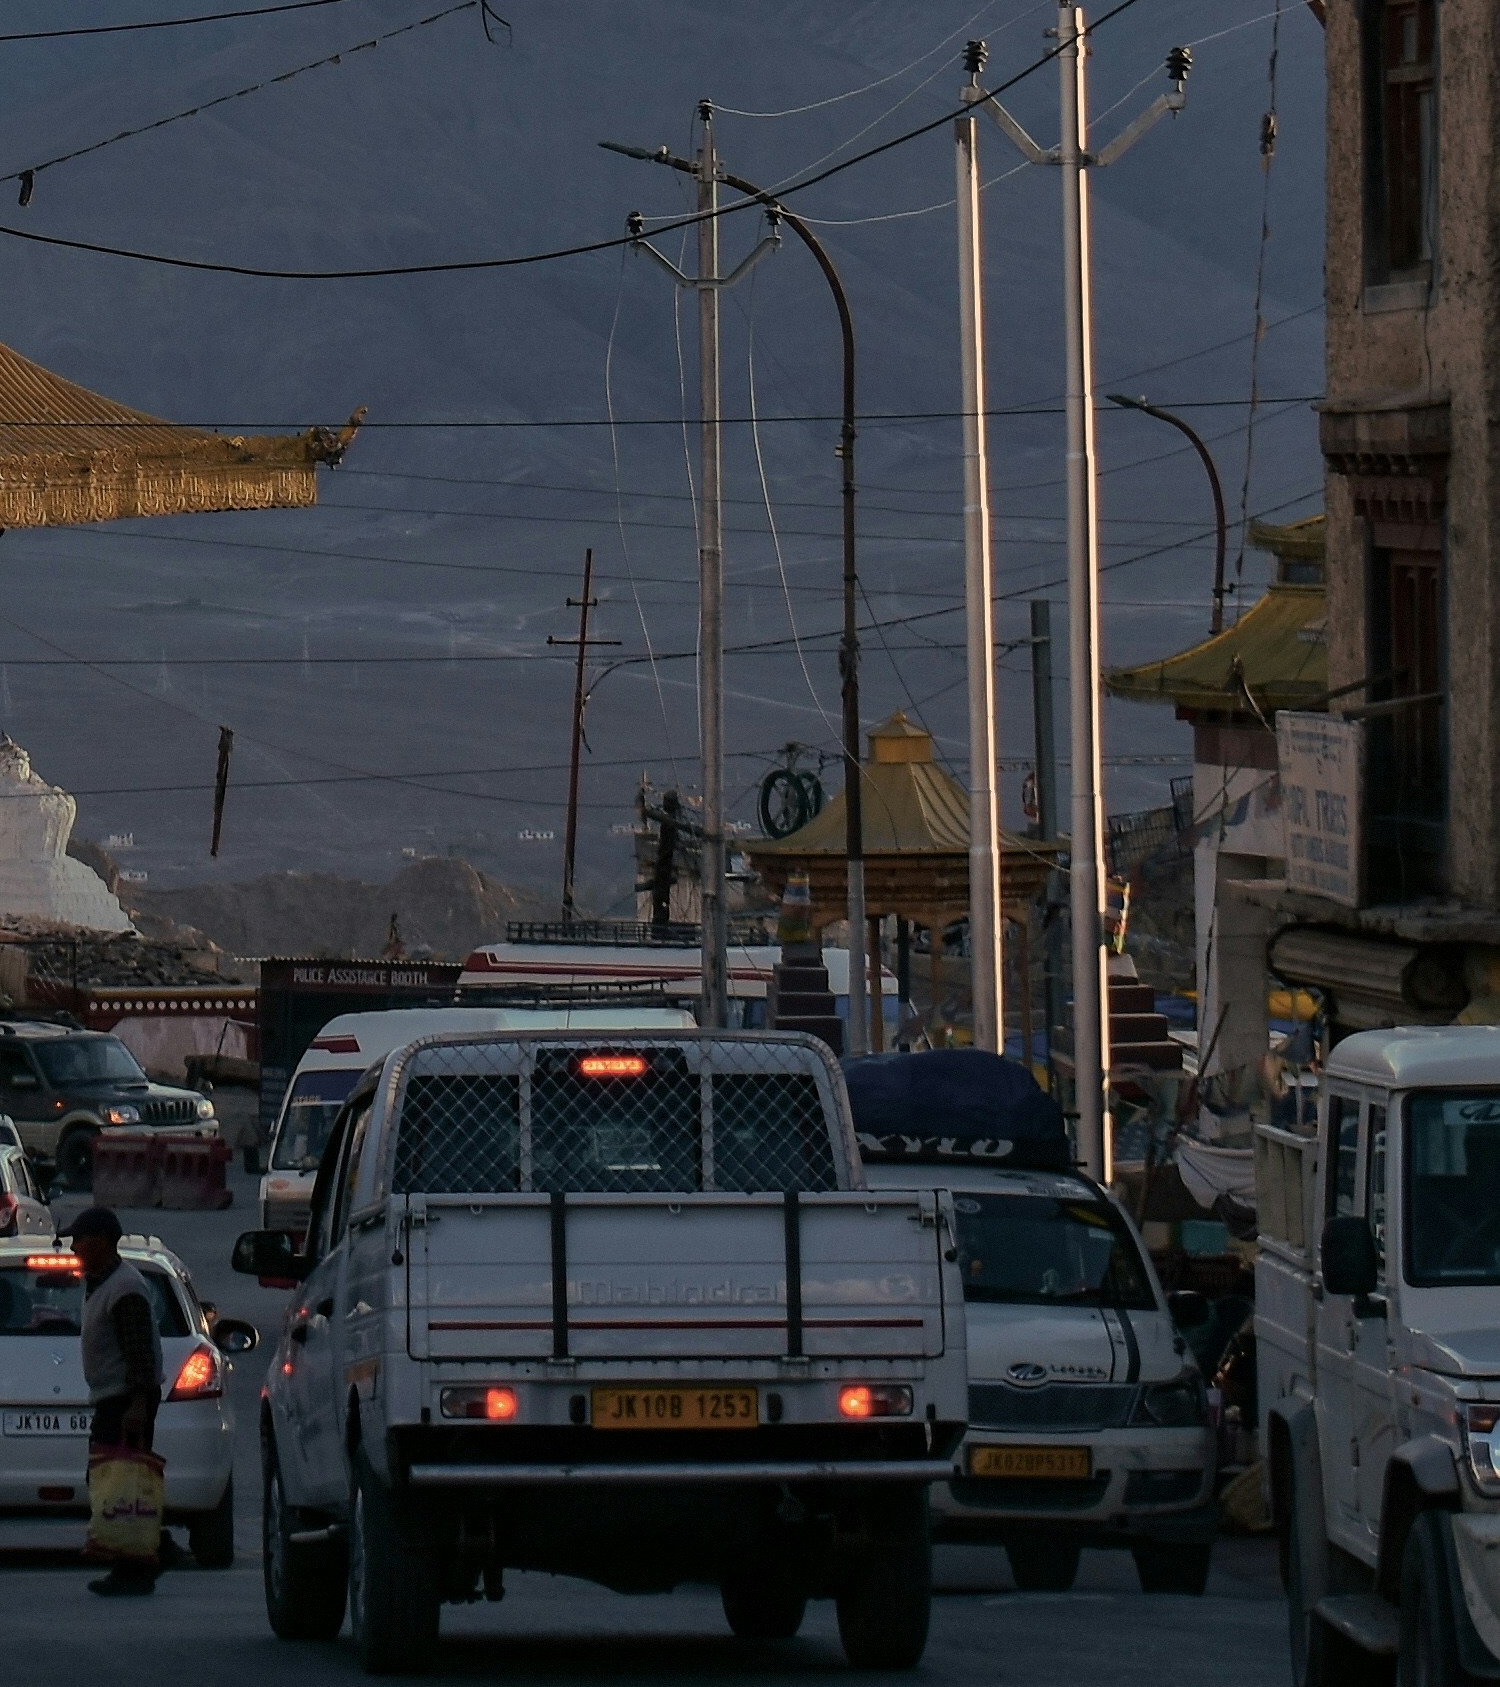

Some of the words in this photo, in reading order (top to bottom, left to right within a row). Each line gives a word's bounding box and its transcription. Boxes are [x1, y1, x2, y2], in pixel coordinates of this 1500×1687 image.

[293, 967, 324, 983] POLICE
[391, 970, 428, 985] BOOTH
[696, 1393, 753, 1419] 1253
[15, 1415, 61, 1431] JK10A
